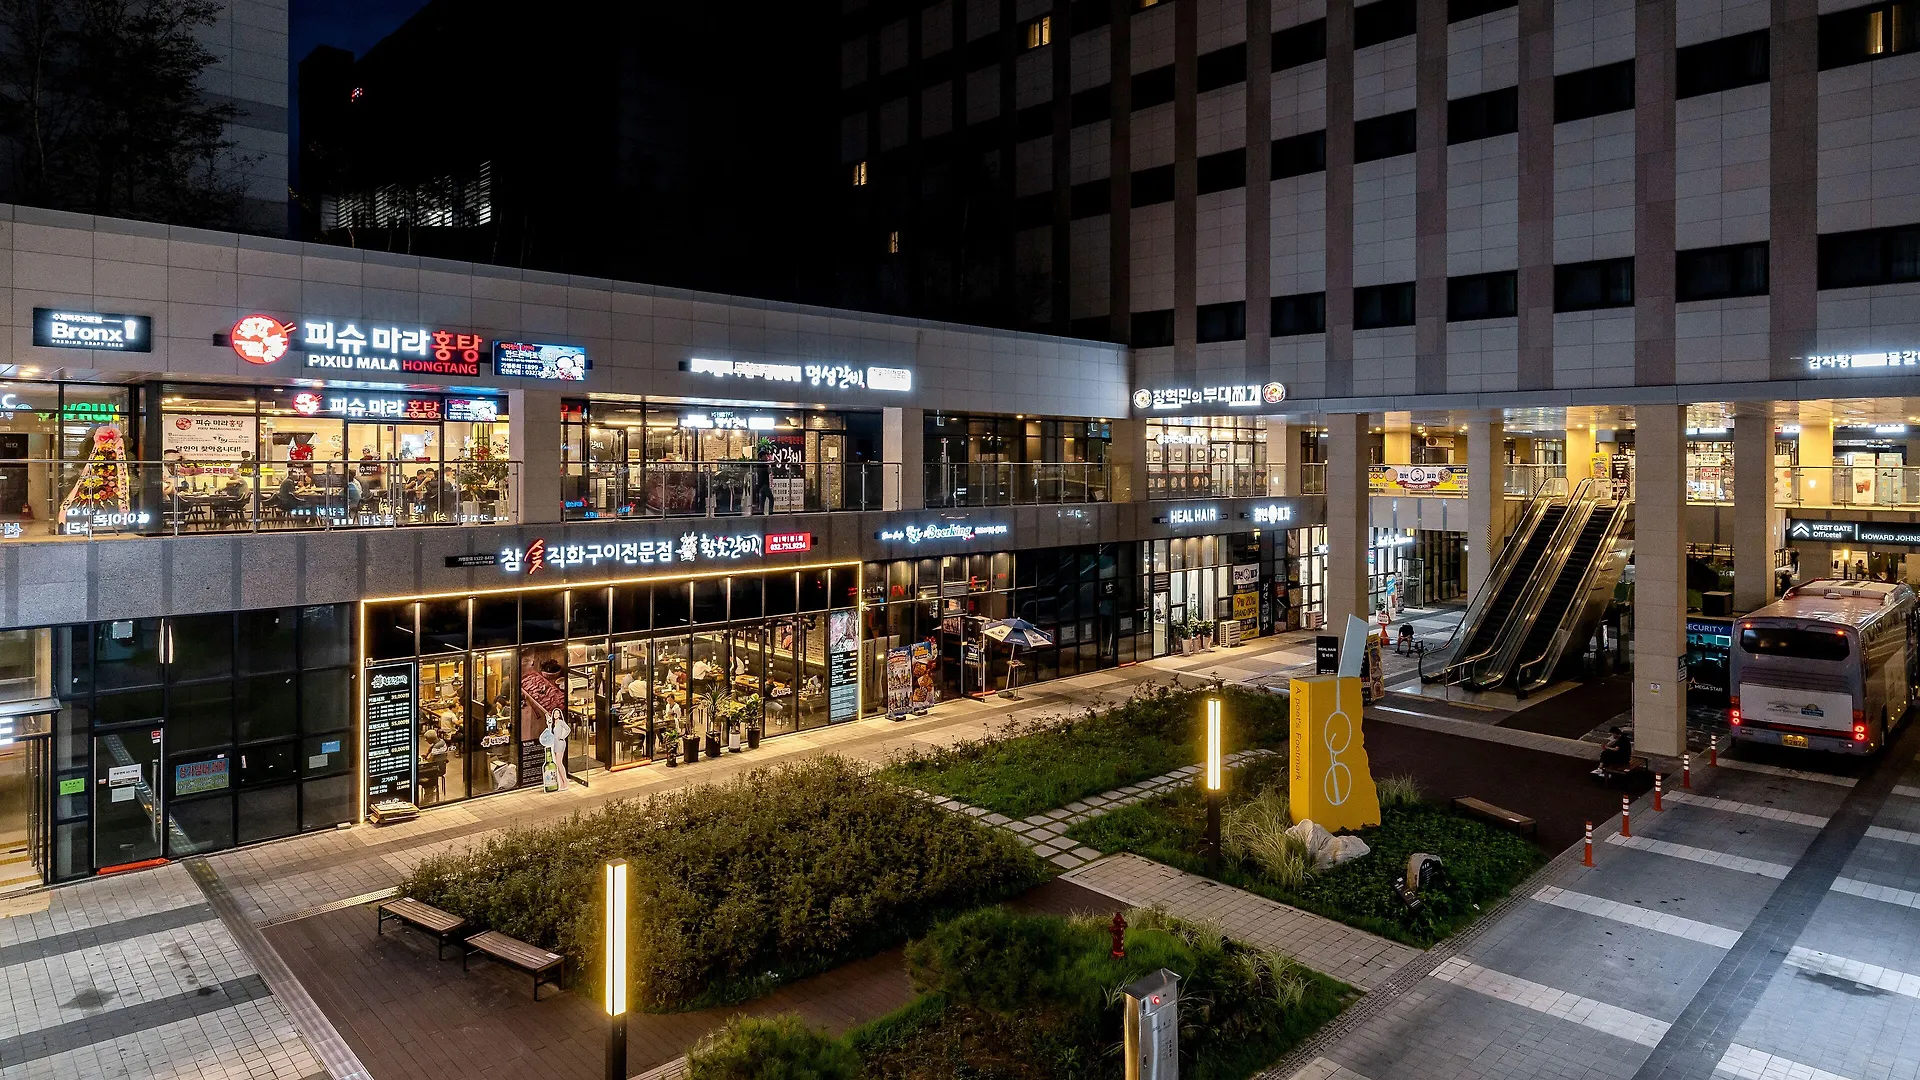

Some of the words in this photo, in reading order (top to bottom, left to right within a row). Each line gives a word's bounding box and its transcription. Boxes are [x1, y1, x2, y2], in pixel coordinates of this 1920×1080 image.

[51, 322, 123, 343] Bronx
[305, 322, 367, 355] 피슈
[372, 327, 431, 356] 마라
[430, 329, 482, 363] 홍탕
[309, 355, 353, 368] PIXIU
[356, 358, 399, 371] MALA
[402, 361, 478, 375] HONGTANG
[1808, 354, 1850, 370] 감자탕
[1887, 350, 1920, 367] 물갈
[1203, 385, 1261, 405] 부대찌개
[331, 397, 367, 417] 피슈
[1170, 510, 1194, 524] HEAL
[1194, 508, 1216, 522] HAIR
[1813, 531, 1842, 539] Officetel
[1234, 608, 1246, 617] GRAND
[1246, 607, 1257, 616] OPEN
[1295, 686, 1301, 694] A
